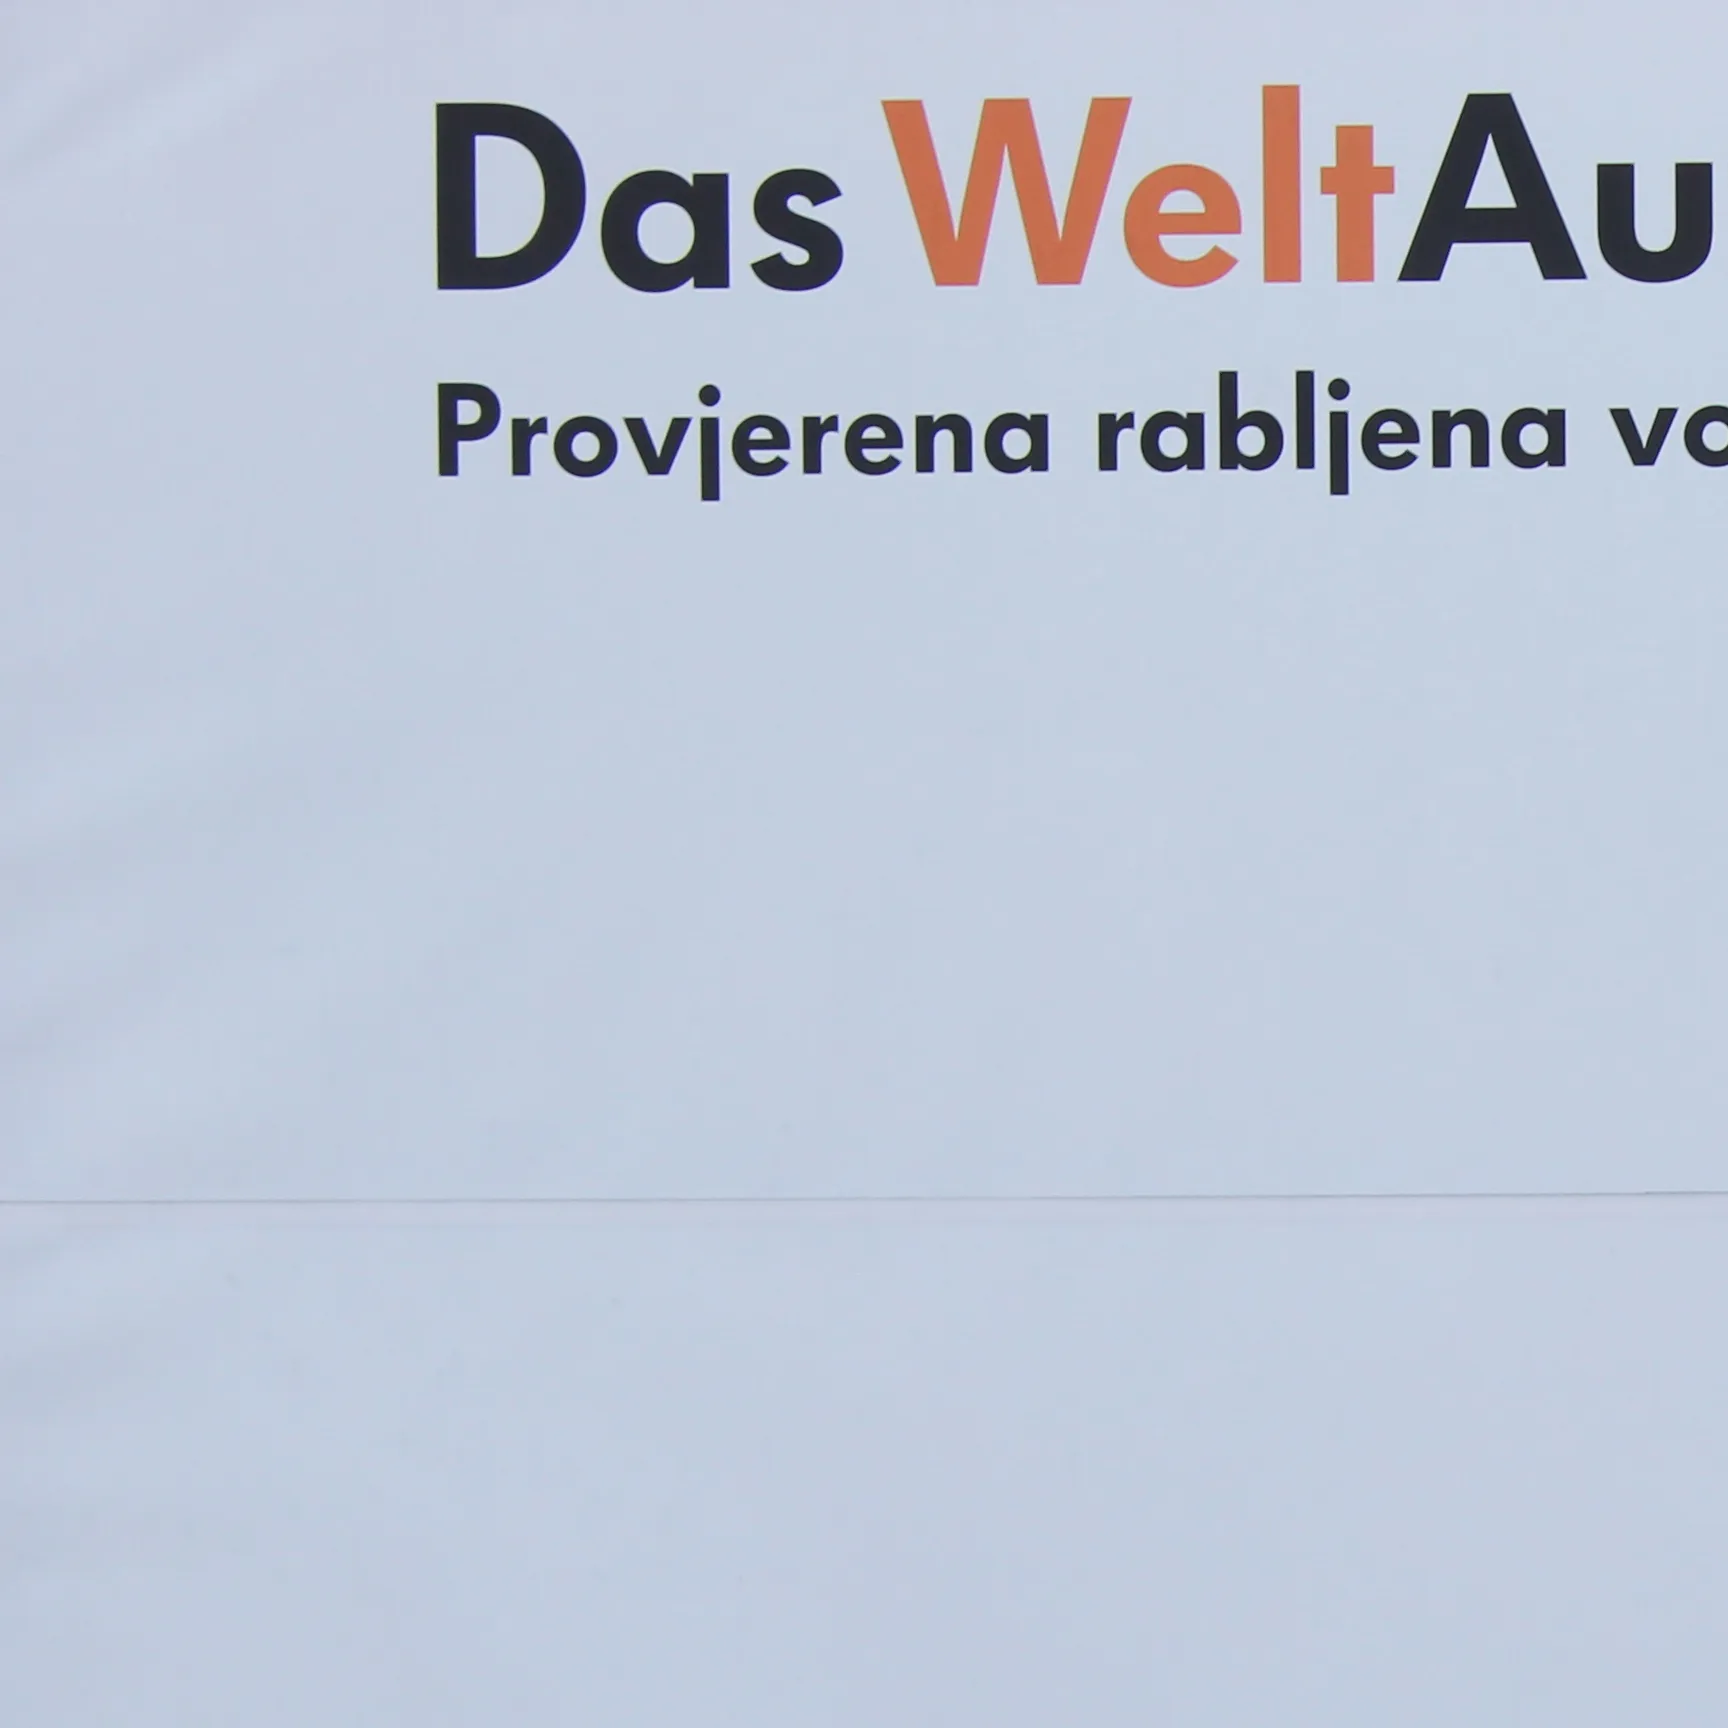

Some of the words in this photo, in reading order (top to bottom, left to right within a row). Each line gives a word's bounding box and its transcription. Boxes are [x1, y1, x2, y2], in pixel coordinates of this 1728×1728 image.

[433, 101, 843, 292] Das
[436, 383, 1049, 502] Provjerena
[1096, 371, 1567, 496] rabljena
